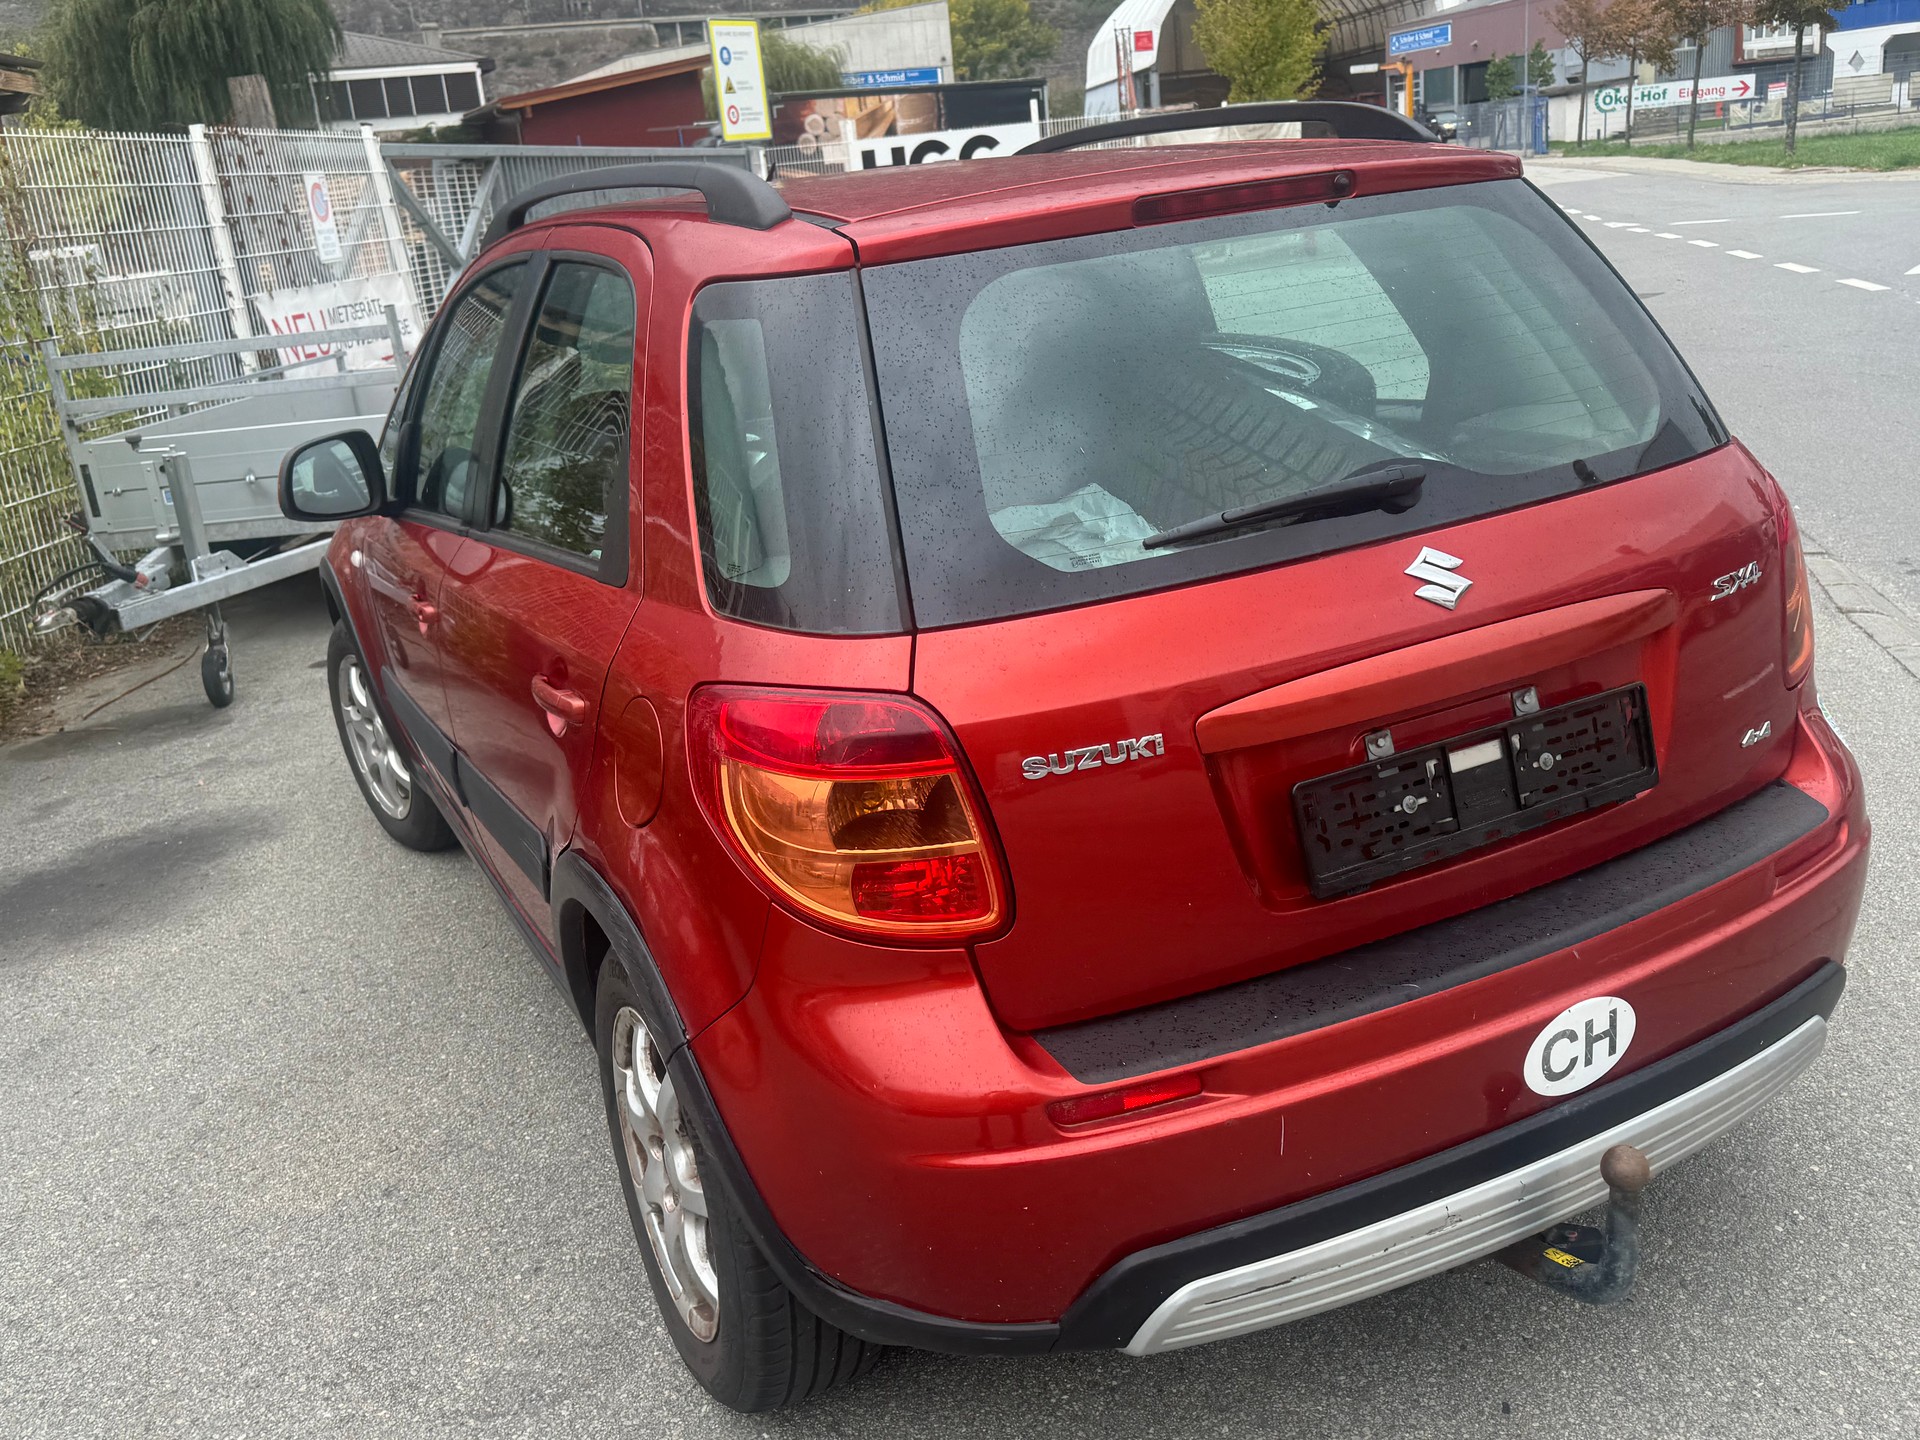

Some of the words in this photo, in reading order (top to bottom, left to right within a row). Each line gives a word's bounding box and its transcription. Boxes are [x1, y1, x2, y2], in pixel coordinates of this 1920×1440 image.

[867, 74, 874, 83] &
[875, 72, 905, 83] Schmid
[1710, 560, 1762, 601] SX4
[1022, 733, 1164, 780] SUZUKI
[1541, 1007, 1618, 1082] CH
